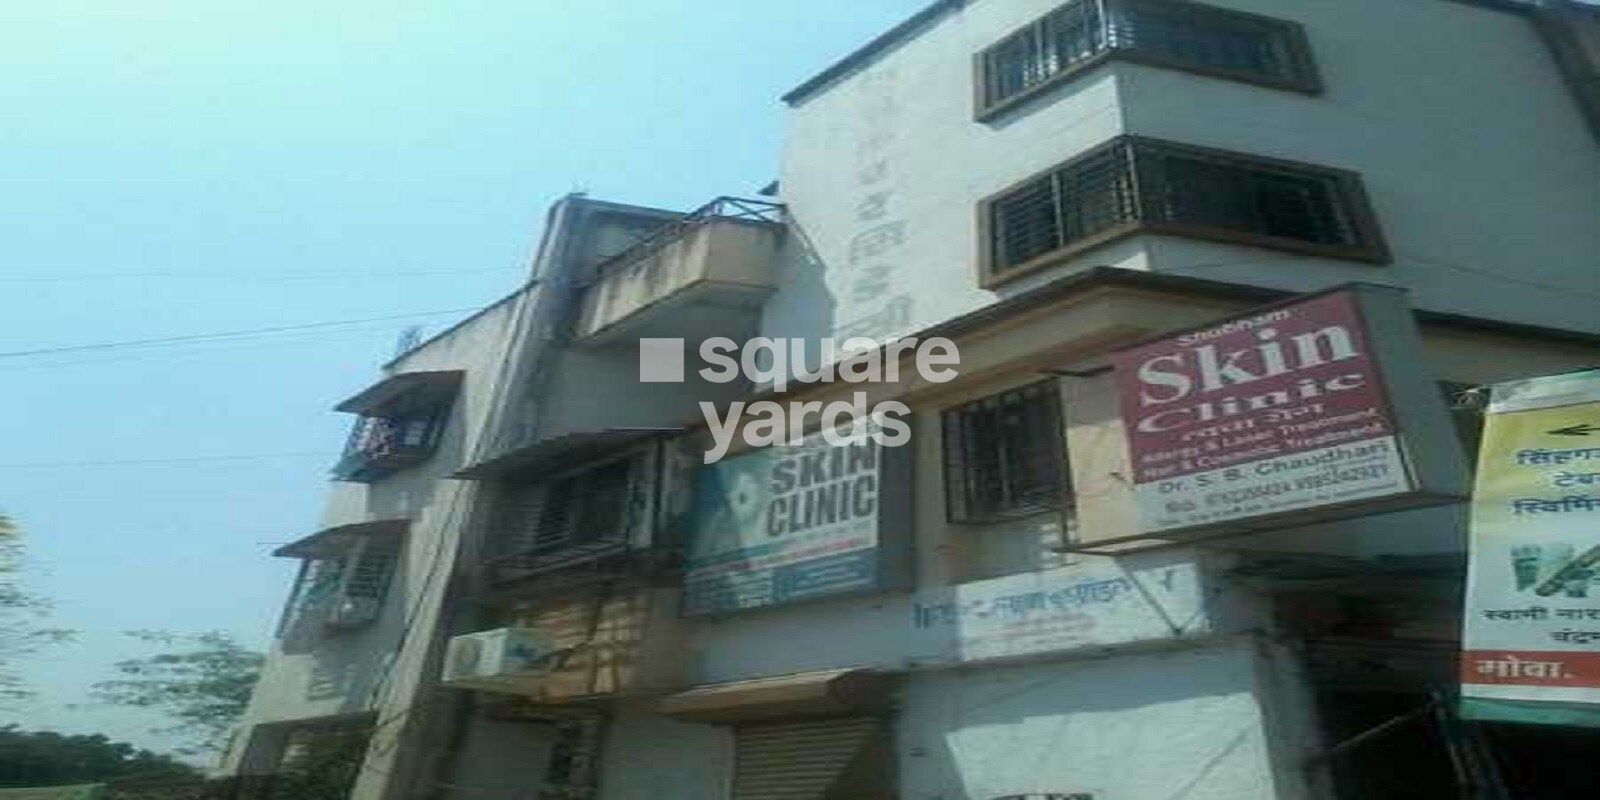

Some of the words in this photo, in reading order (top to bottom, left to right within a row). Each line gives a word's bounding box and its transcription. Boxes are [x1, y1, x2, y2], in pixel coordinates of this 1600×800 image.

[1138, 325, 1358, 406] Skin
[1138, 374, 1365, 432] Clinic
[773, 437, 876, 496] SKIN
[1253, 440, 1388, 476] Chaudhari
[768, 473, 876, 537] CLINIC
[1483, 605, 1548, 620] स्वामी
